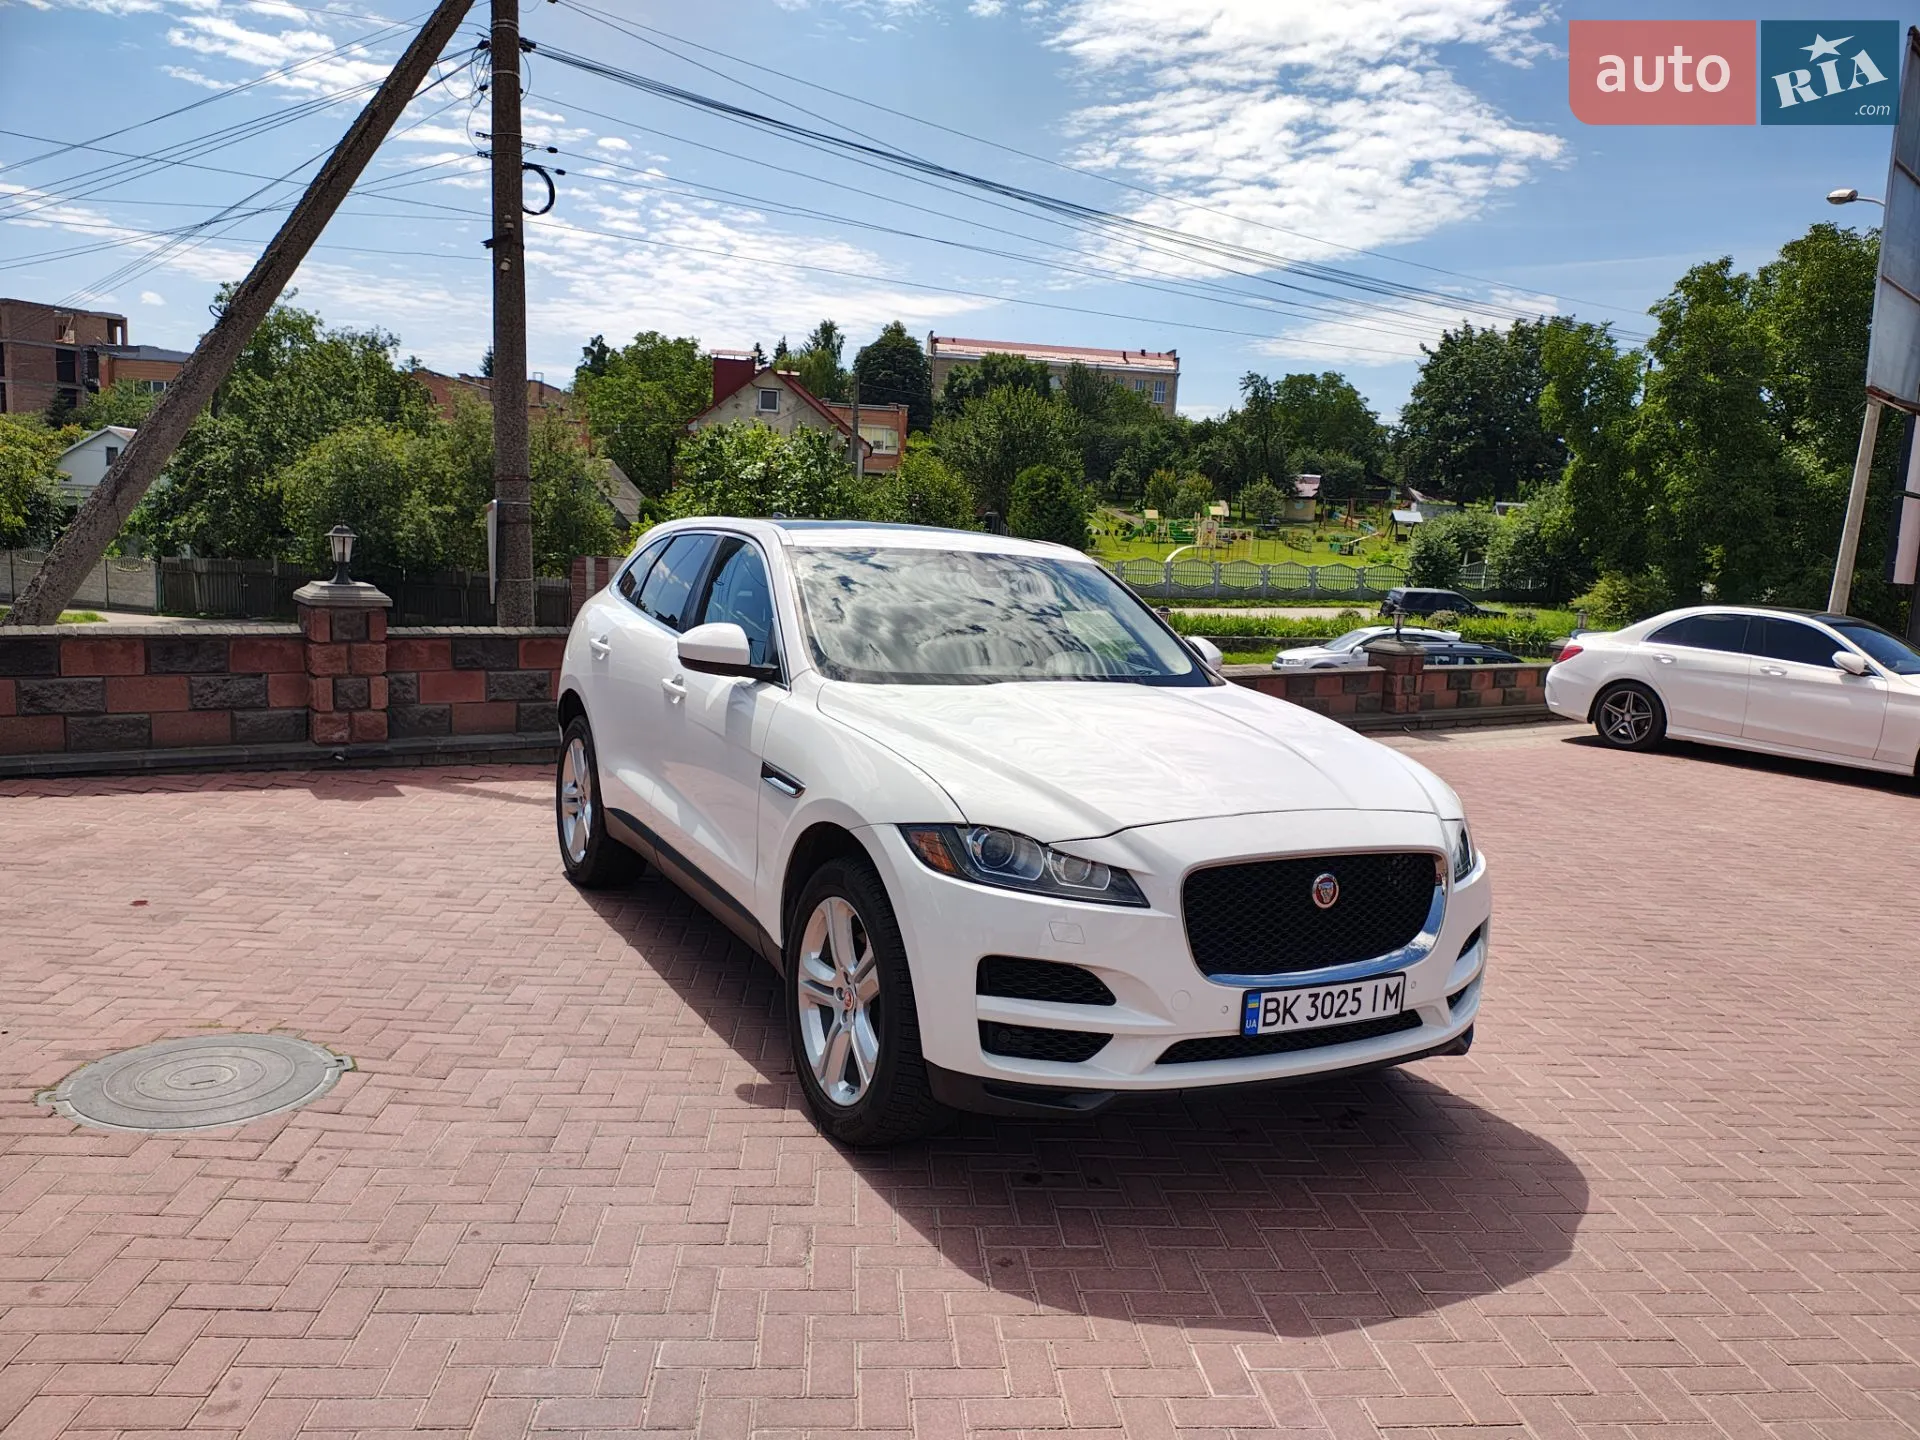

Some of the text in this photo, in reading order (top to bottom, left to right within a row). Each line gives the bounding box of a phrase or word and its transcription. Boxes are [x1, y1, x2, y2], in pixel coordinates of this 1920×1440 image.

[1261, 981, 1402, 1027] BK 3025 IM
[1245, 1018, 1257, 1029] UA
